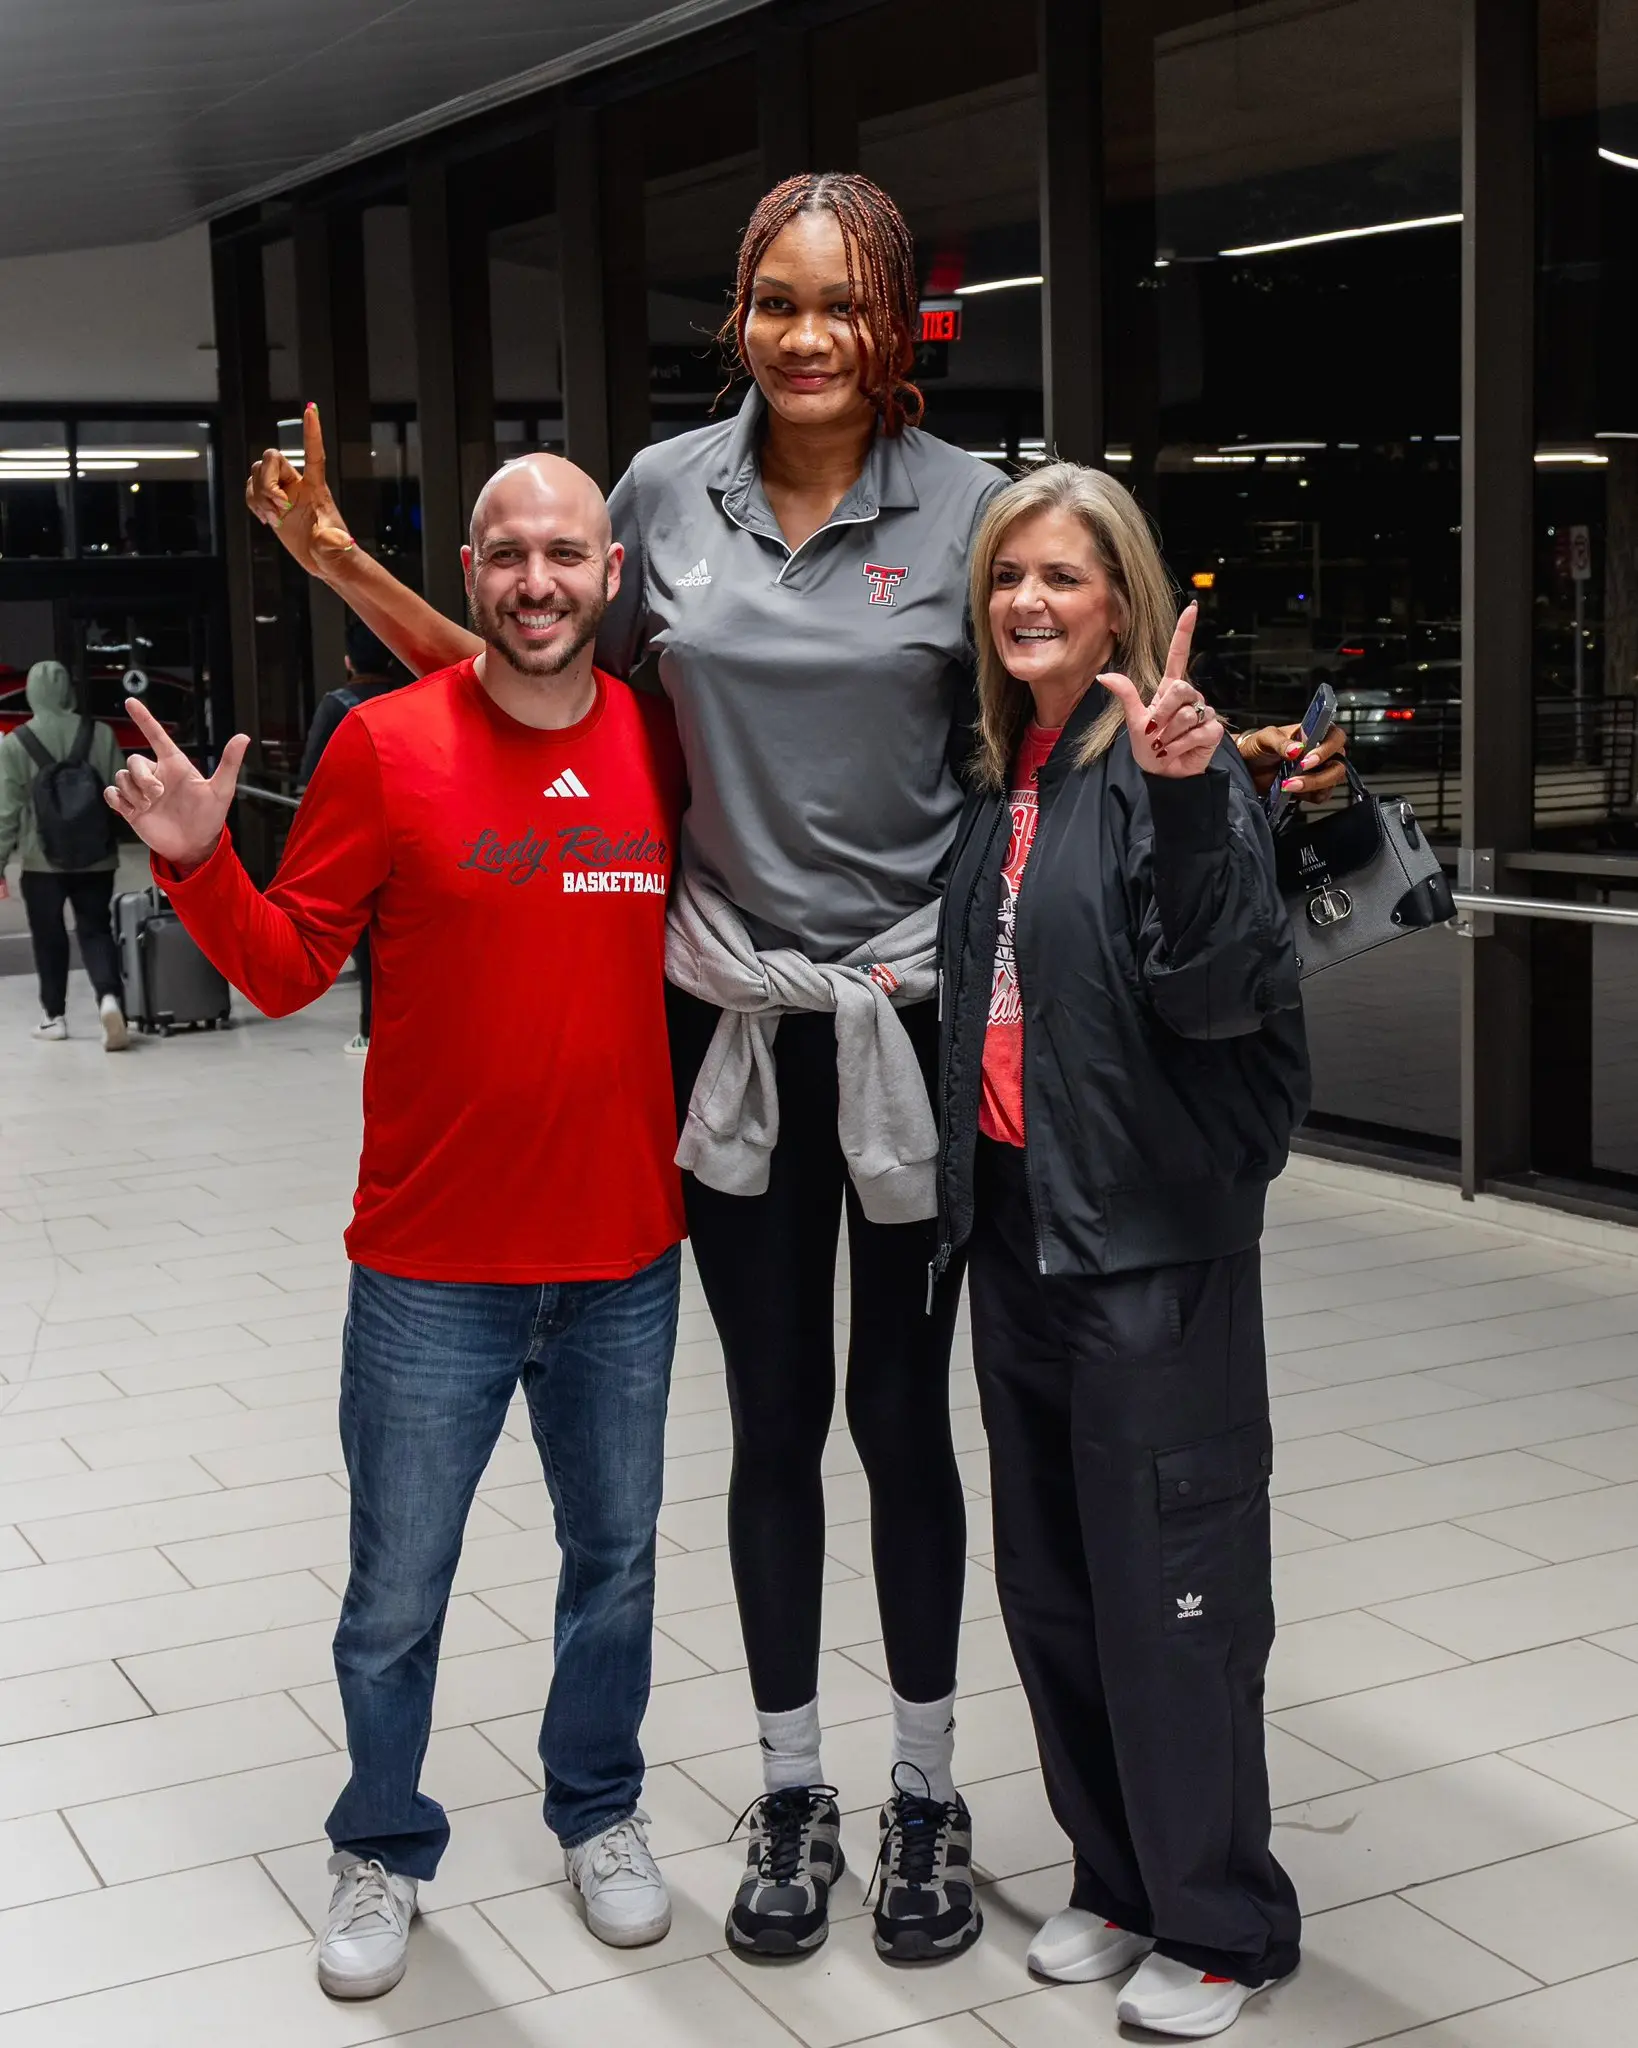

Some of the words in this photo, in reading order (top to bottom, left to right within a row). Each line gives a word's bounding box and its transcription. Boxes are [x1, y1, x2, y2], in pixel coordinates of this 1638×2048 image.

[675, 576, 712, 587] adidas
[457, 826, 550, 885] Lady
[557, 825, 668, 867] Raider
[562, 871, 667, 896] BASKETBALL
[1177, 1609, 1203, 1618] adidas
